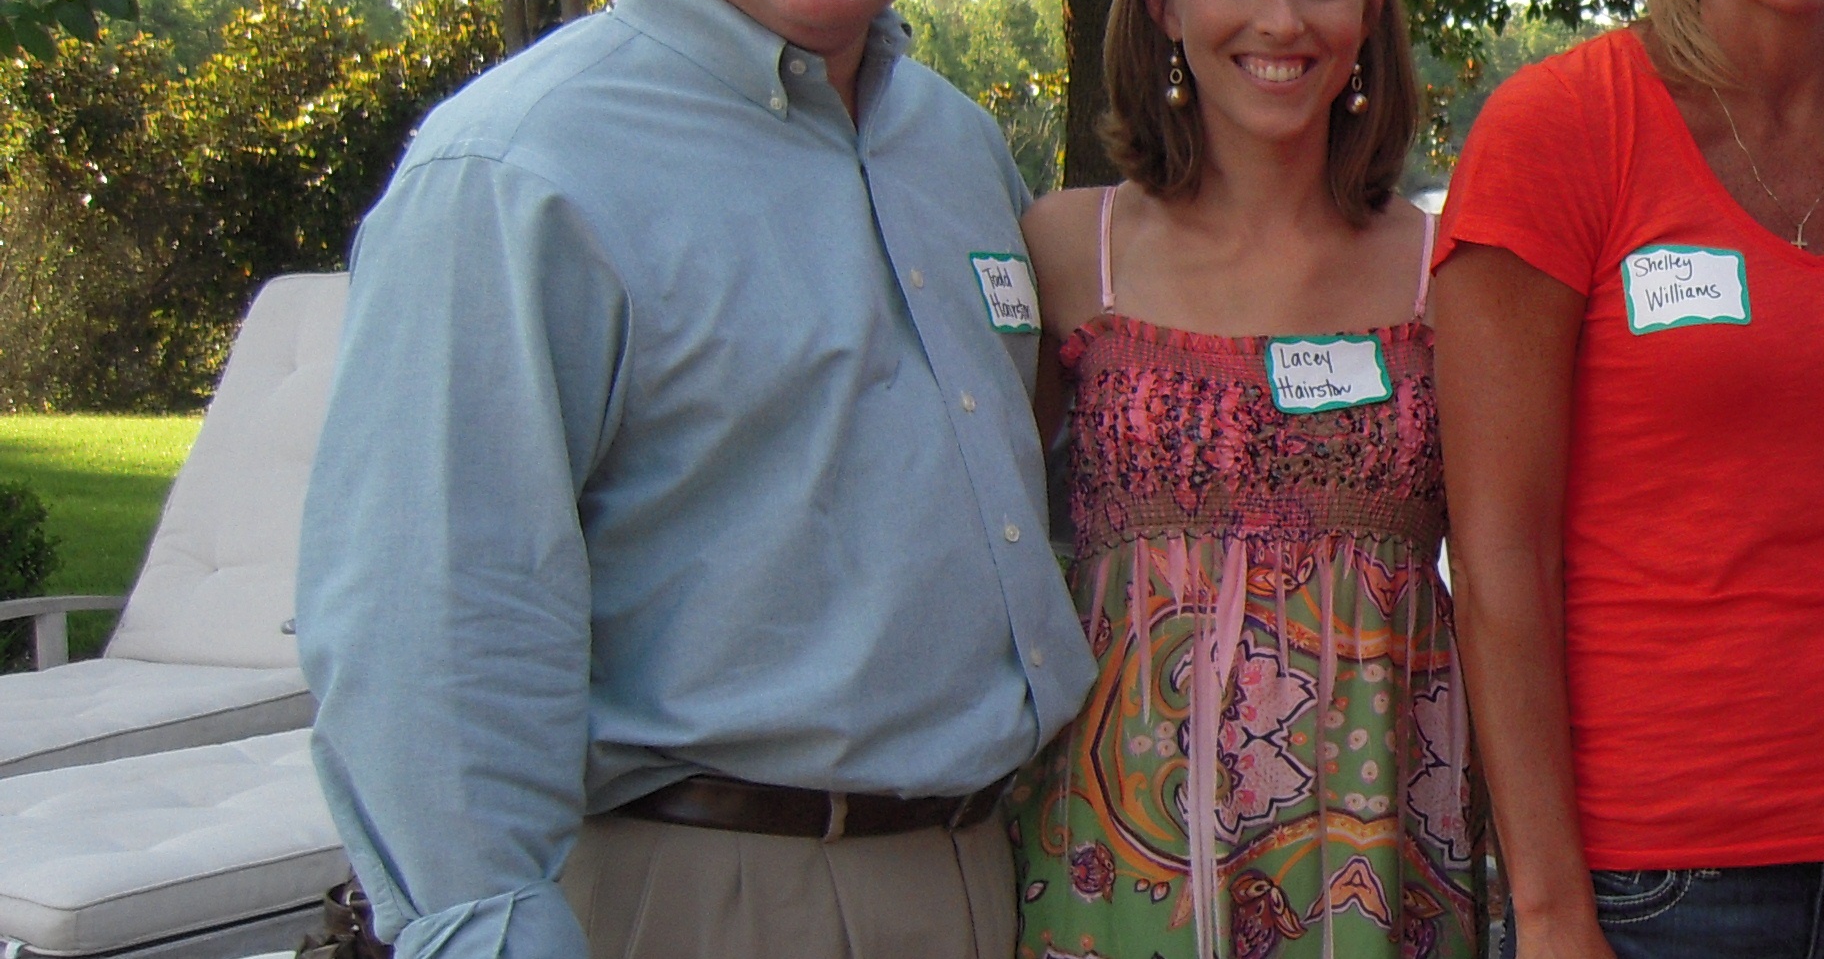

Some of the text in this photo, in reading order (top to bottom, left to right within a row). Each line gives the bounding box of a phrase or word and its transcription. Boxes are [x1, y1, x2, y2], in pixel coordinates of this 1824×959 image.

[982, 266, 1012, 289] Todd
[1634, 254, 1692, 281] Shelley
[1645, 283, 1721, 311] Williams
[1280, 348, 1333, 373] Lacey
[1278, 376, 1351, 399] Hairston
